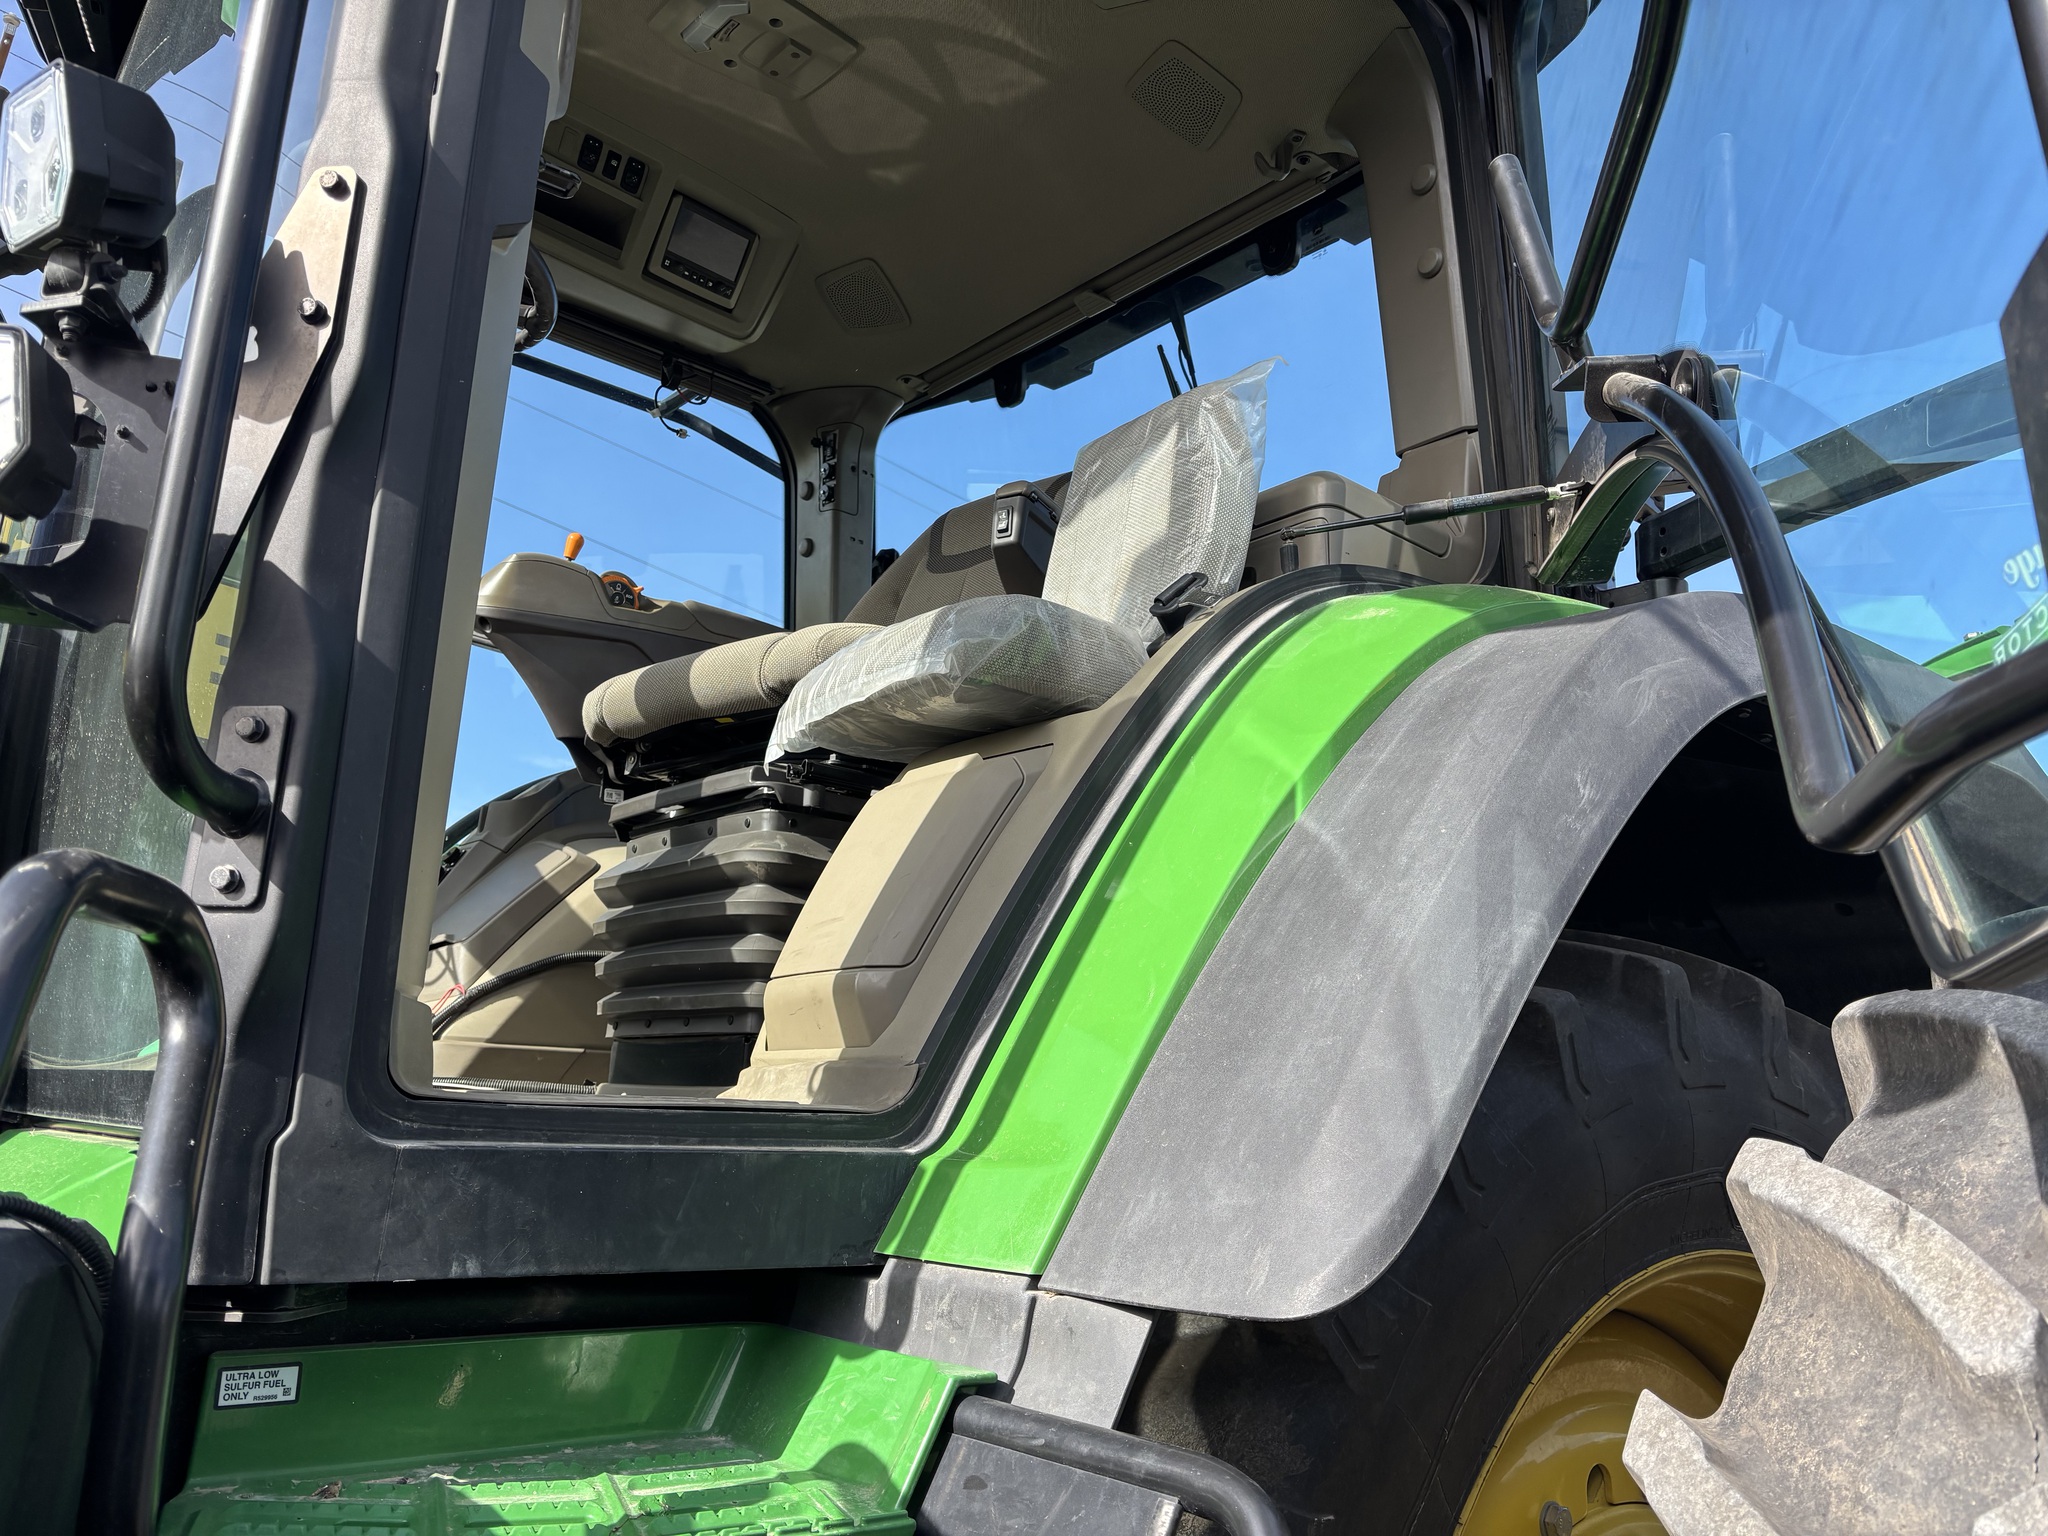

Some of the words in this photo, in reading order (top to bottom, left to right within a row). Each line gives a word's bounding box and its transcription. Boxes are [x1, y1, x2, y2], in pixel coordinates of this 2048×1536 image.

[225, 1372, 256, 1382] ULTRA
[258, 1370, 280, 1379] LOW
[224, 1381, 261, 1391] SULFUR
[263, 1379, 286, 1389] FUEL
[223, 1392, 249, 1402] ONLY
